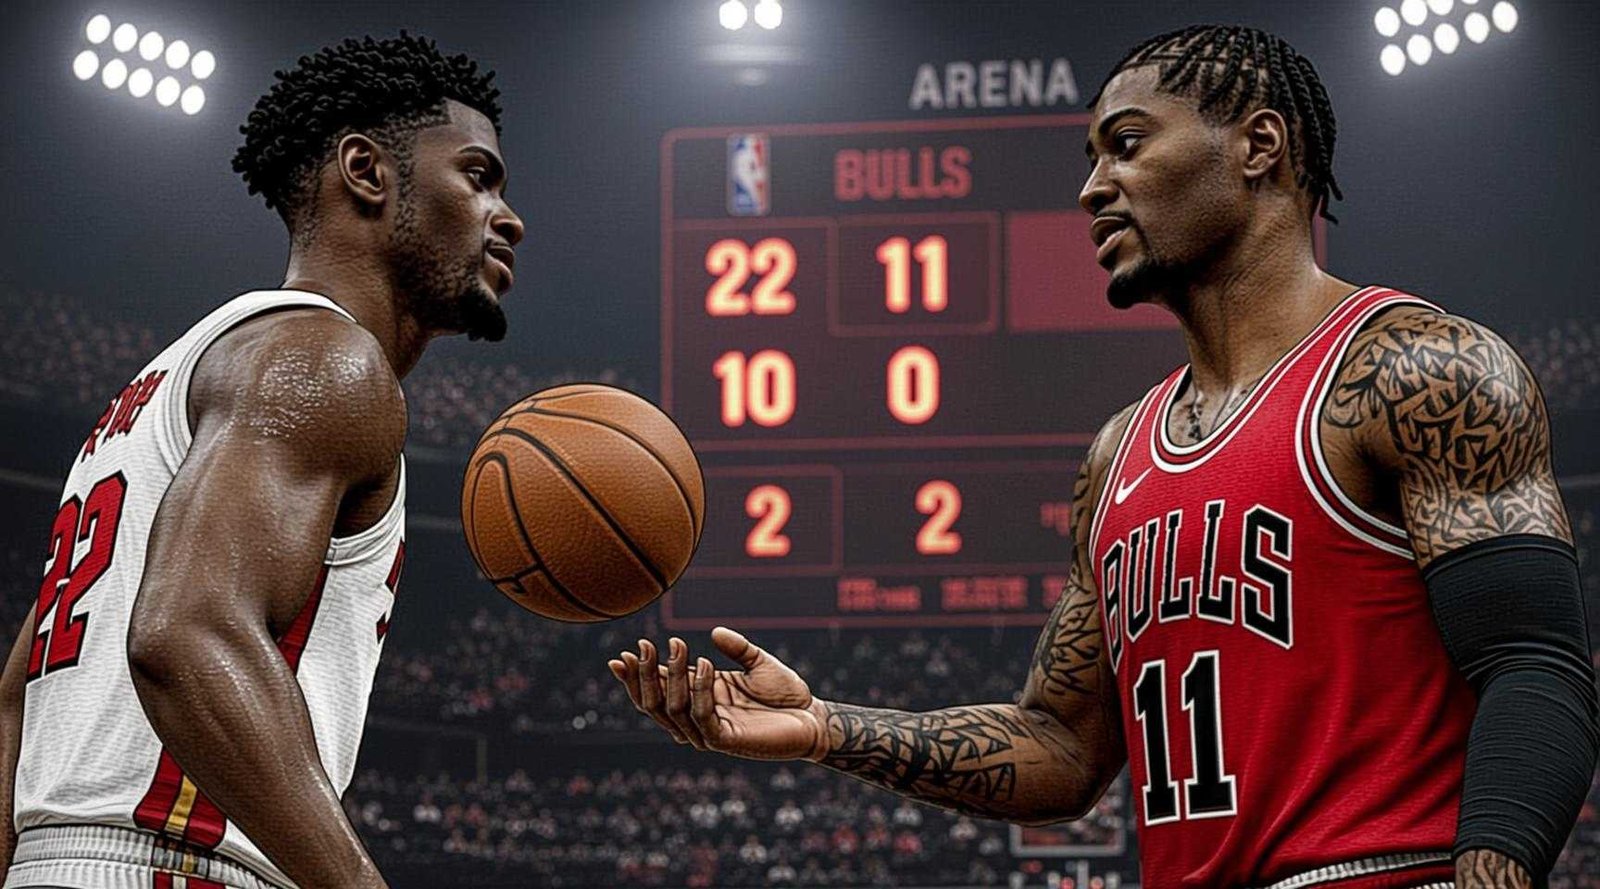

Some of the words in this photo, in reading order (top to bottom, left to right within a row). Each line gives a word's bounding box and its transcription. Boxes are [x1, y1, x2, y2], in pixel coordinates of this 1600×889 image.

[909, 58, 1079, 110] ARENA
[835, 146, 972, 201] BULLS
[705, 237, 797, 317] 22
[876, 234, 949, 313] 11
[712, 349, 796, 428] 10
[886, 345, 941, 424] 0
[744, 484, 793, 558] 2
[914, 479, 962, 555] 2
[26, 470, 128, 681] 22
[1102, 499, 1293, 676] BULLS
[1133, 649, 1237, 826] 11
